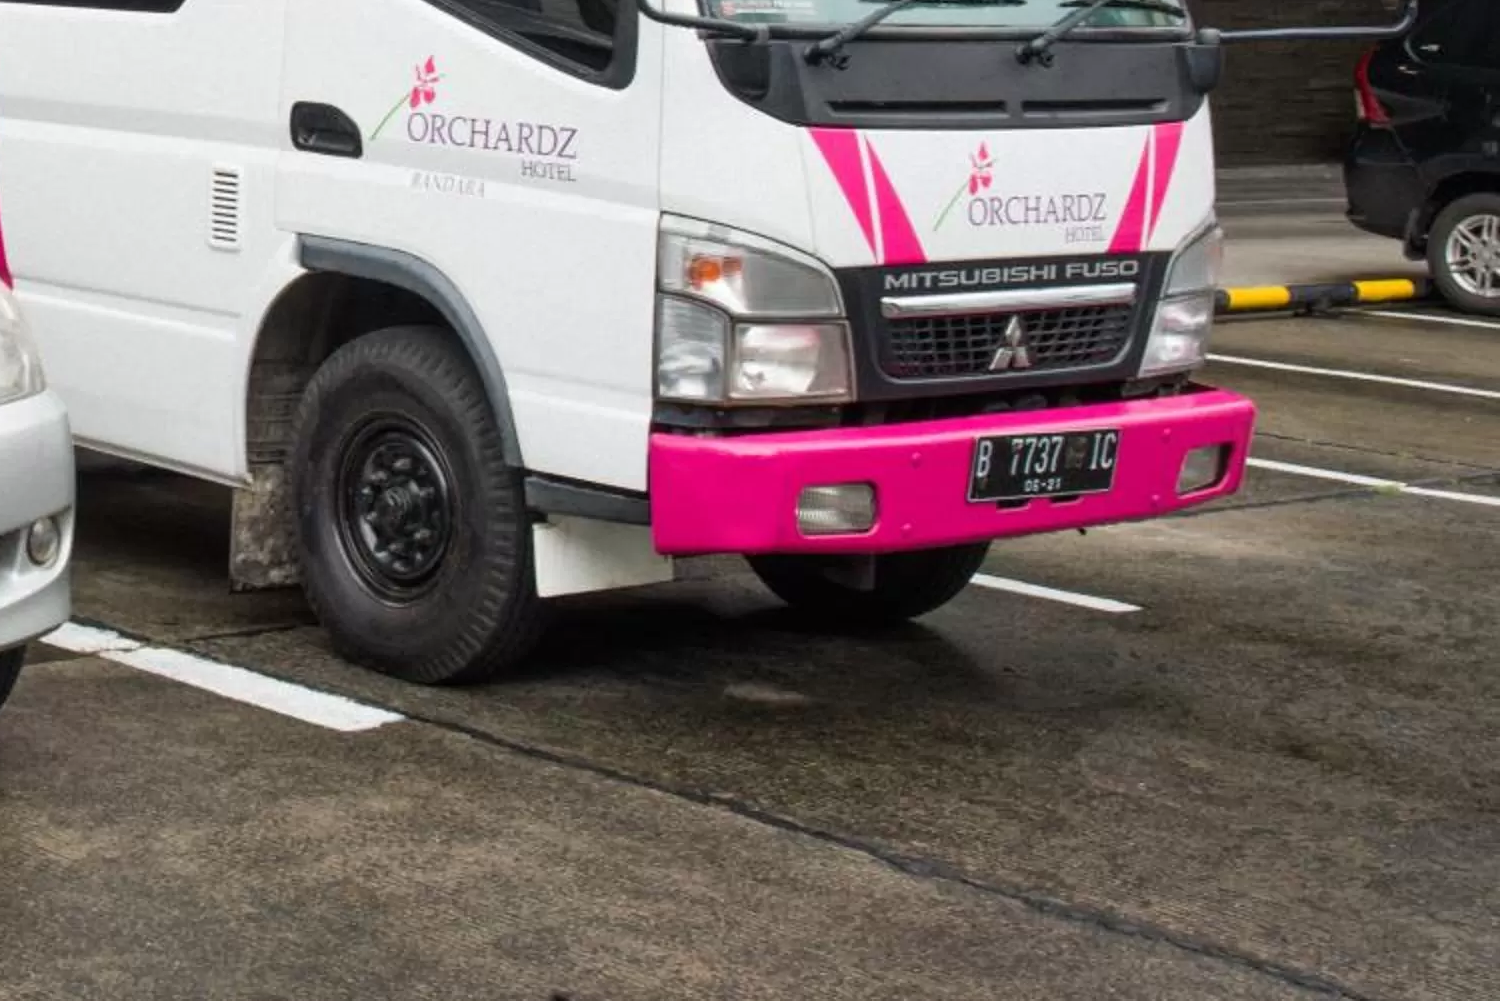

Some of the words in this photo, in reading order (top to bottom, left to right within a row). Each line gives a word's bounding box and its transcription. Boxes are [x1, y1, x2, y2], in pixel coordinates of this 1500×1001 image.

[407, 112, 579, 159] ORCHARDZ
[522, 160, 577, 182] HOTEL
[968, 194, 1107, 226] ORCHARDZ
[1065, 226, 1105, 244] HOTEL
[884, 263, 1056, 290] MITSUBISHI
[1065, 261, 1139, 277] FUSO
[976, 440, 993, 477] B
[1010, 436, 1064, 475] 7737
